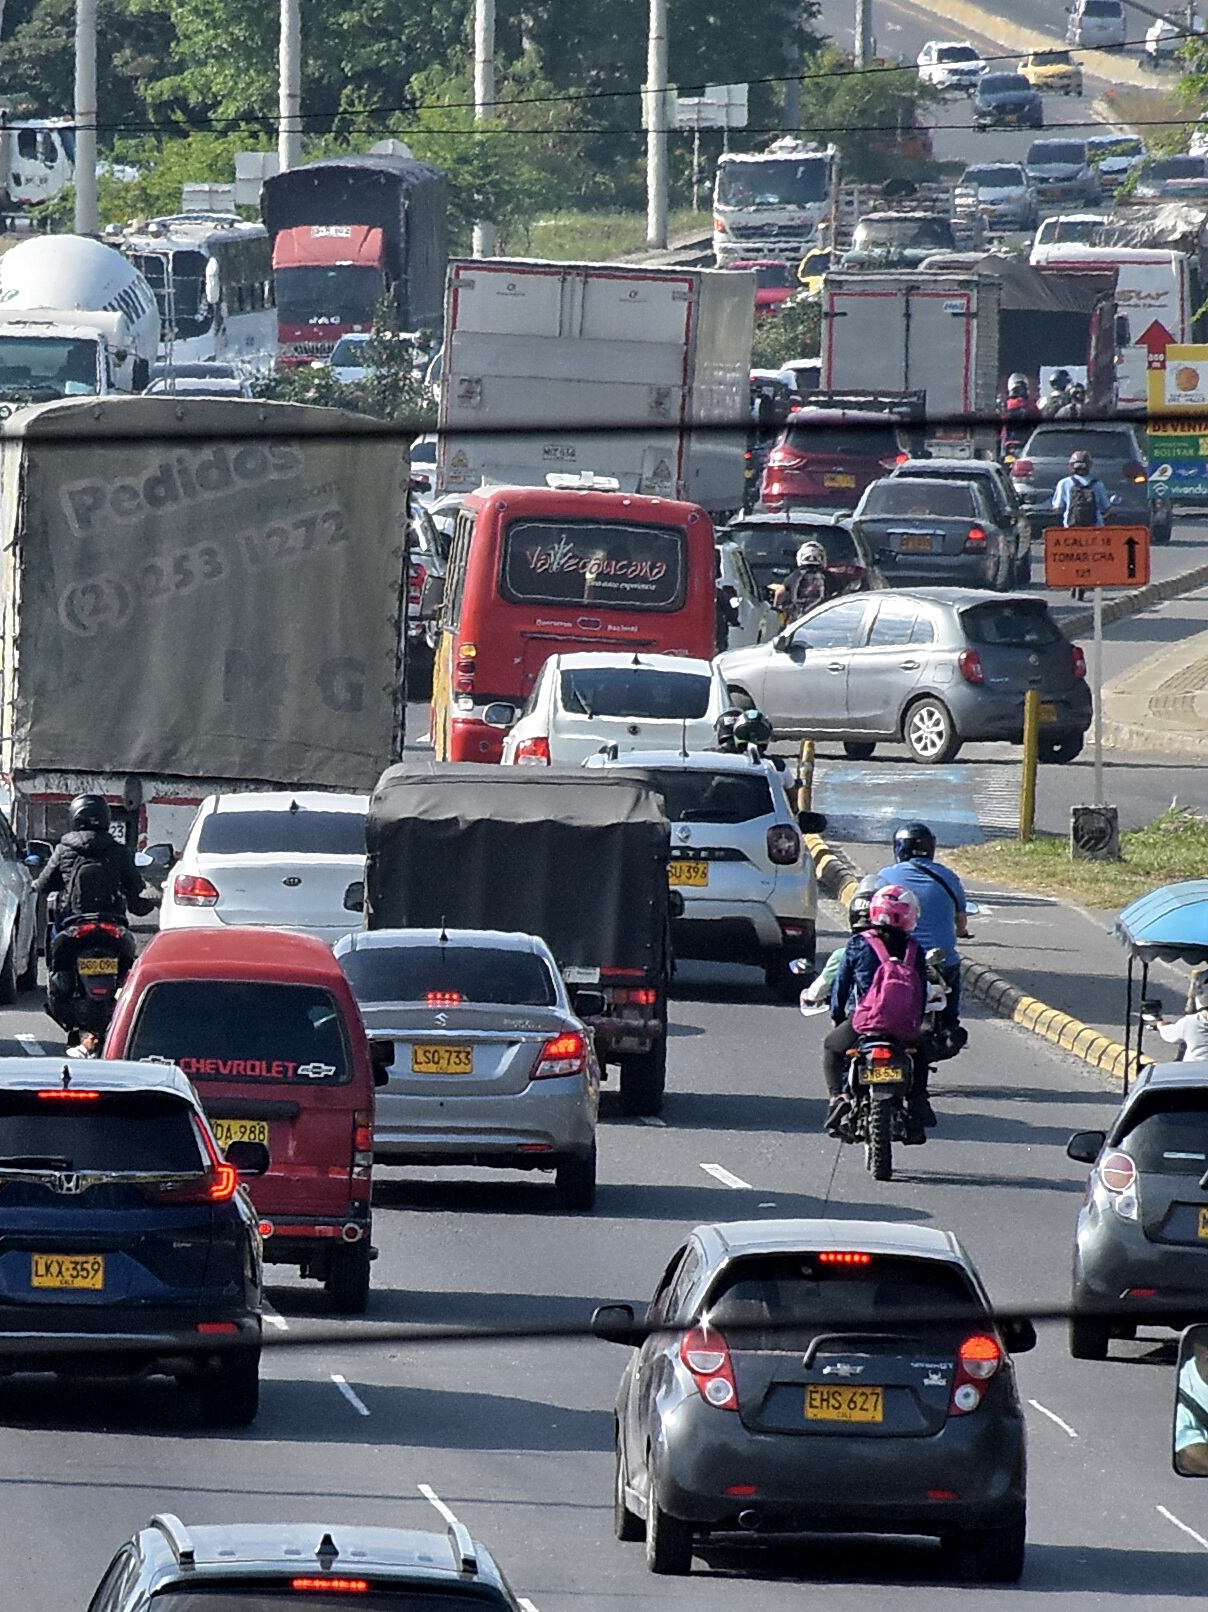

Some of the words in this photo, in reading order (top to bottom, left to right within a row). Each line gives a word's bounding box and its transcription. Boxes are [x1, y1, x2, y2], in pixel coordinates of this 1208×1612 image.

[1153, 423, 1168, 433] DE
[62, 441, 300, 534] Pedidos
[1054, 538, 1061, 547] A
[179, 1057, 297, 1078] CHEVROLET
